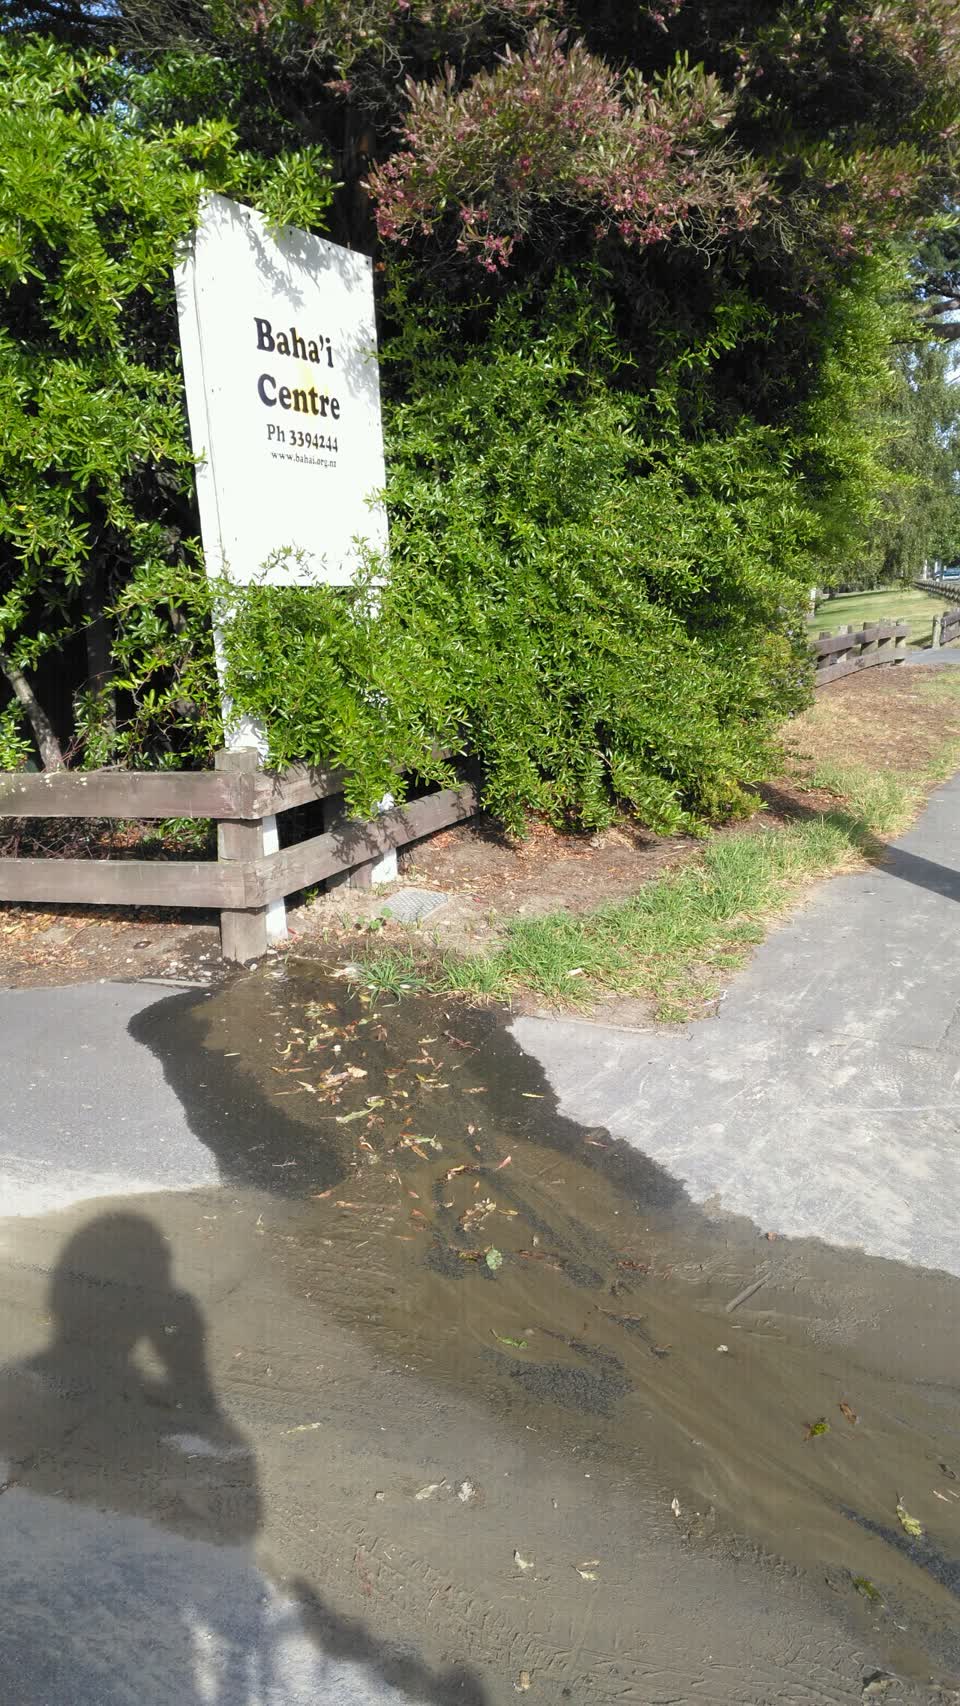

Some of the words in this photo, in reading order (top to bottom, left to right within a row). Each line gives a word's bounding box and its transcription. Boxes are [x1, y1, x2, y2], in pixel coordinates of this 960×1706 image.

[253, 316, 334, 368] Baha'i
[257, 373, 340, 420] Centre
[266, 423, 286, 443] Ph
[289, 429, 339, 453] 3394244
[271, 451, 337, 468] www.bahai.org.nz
